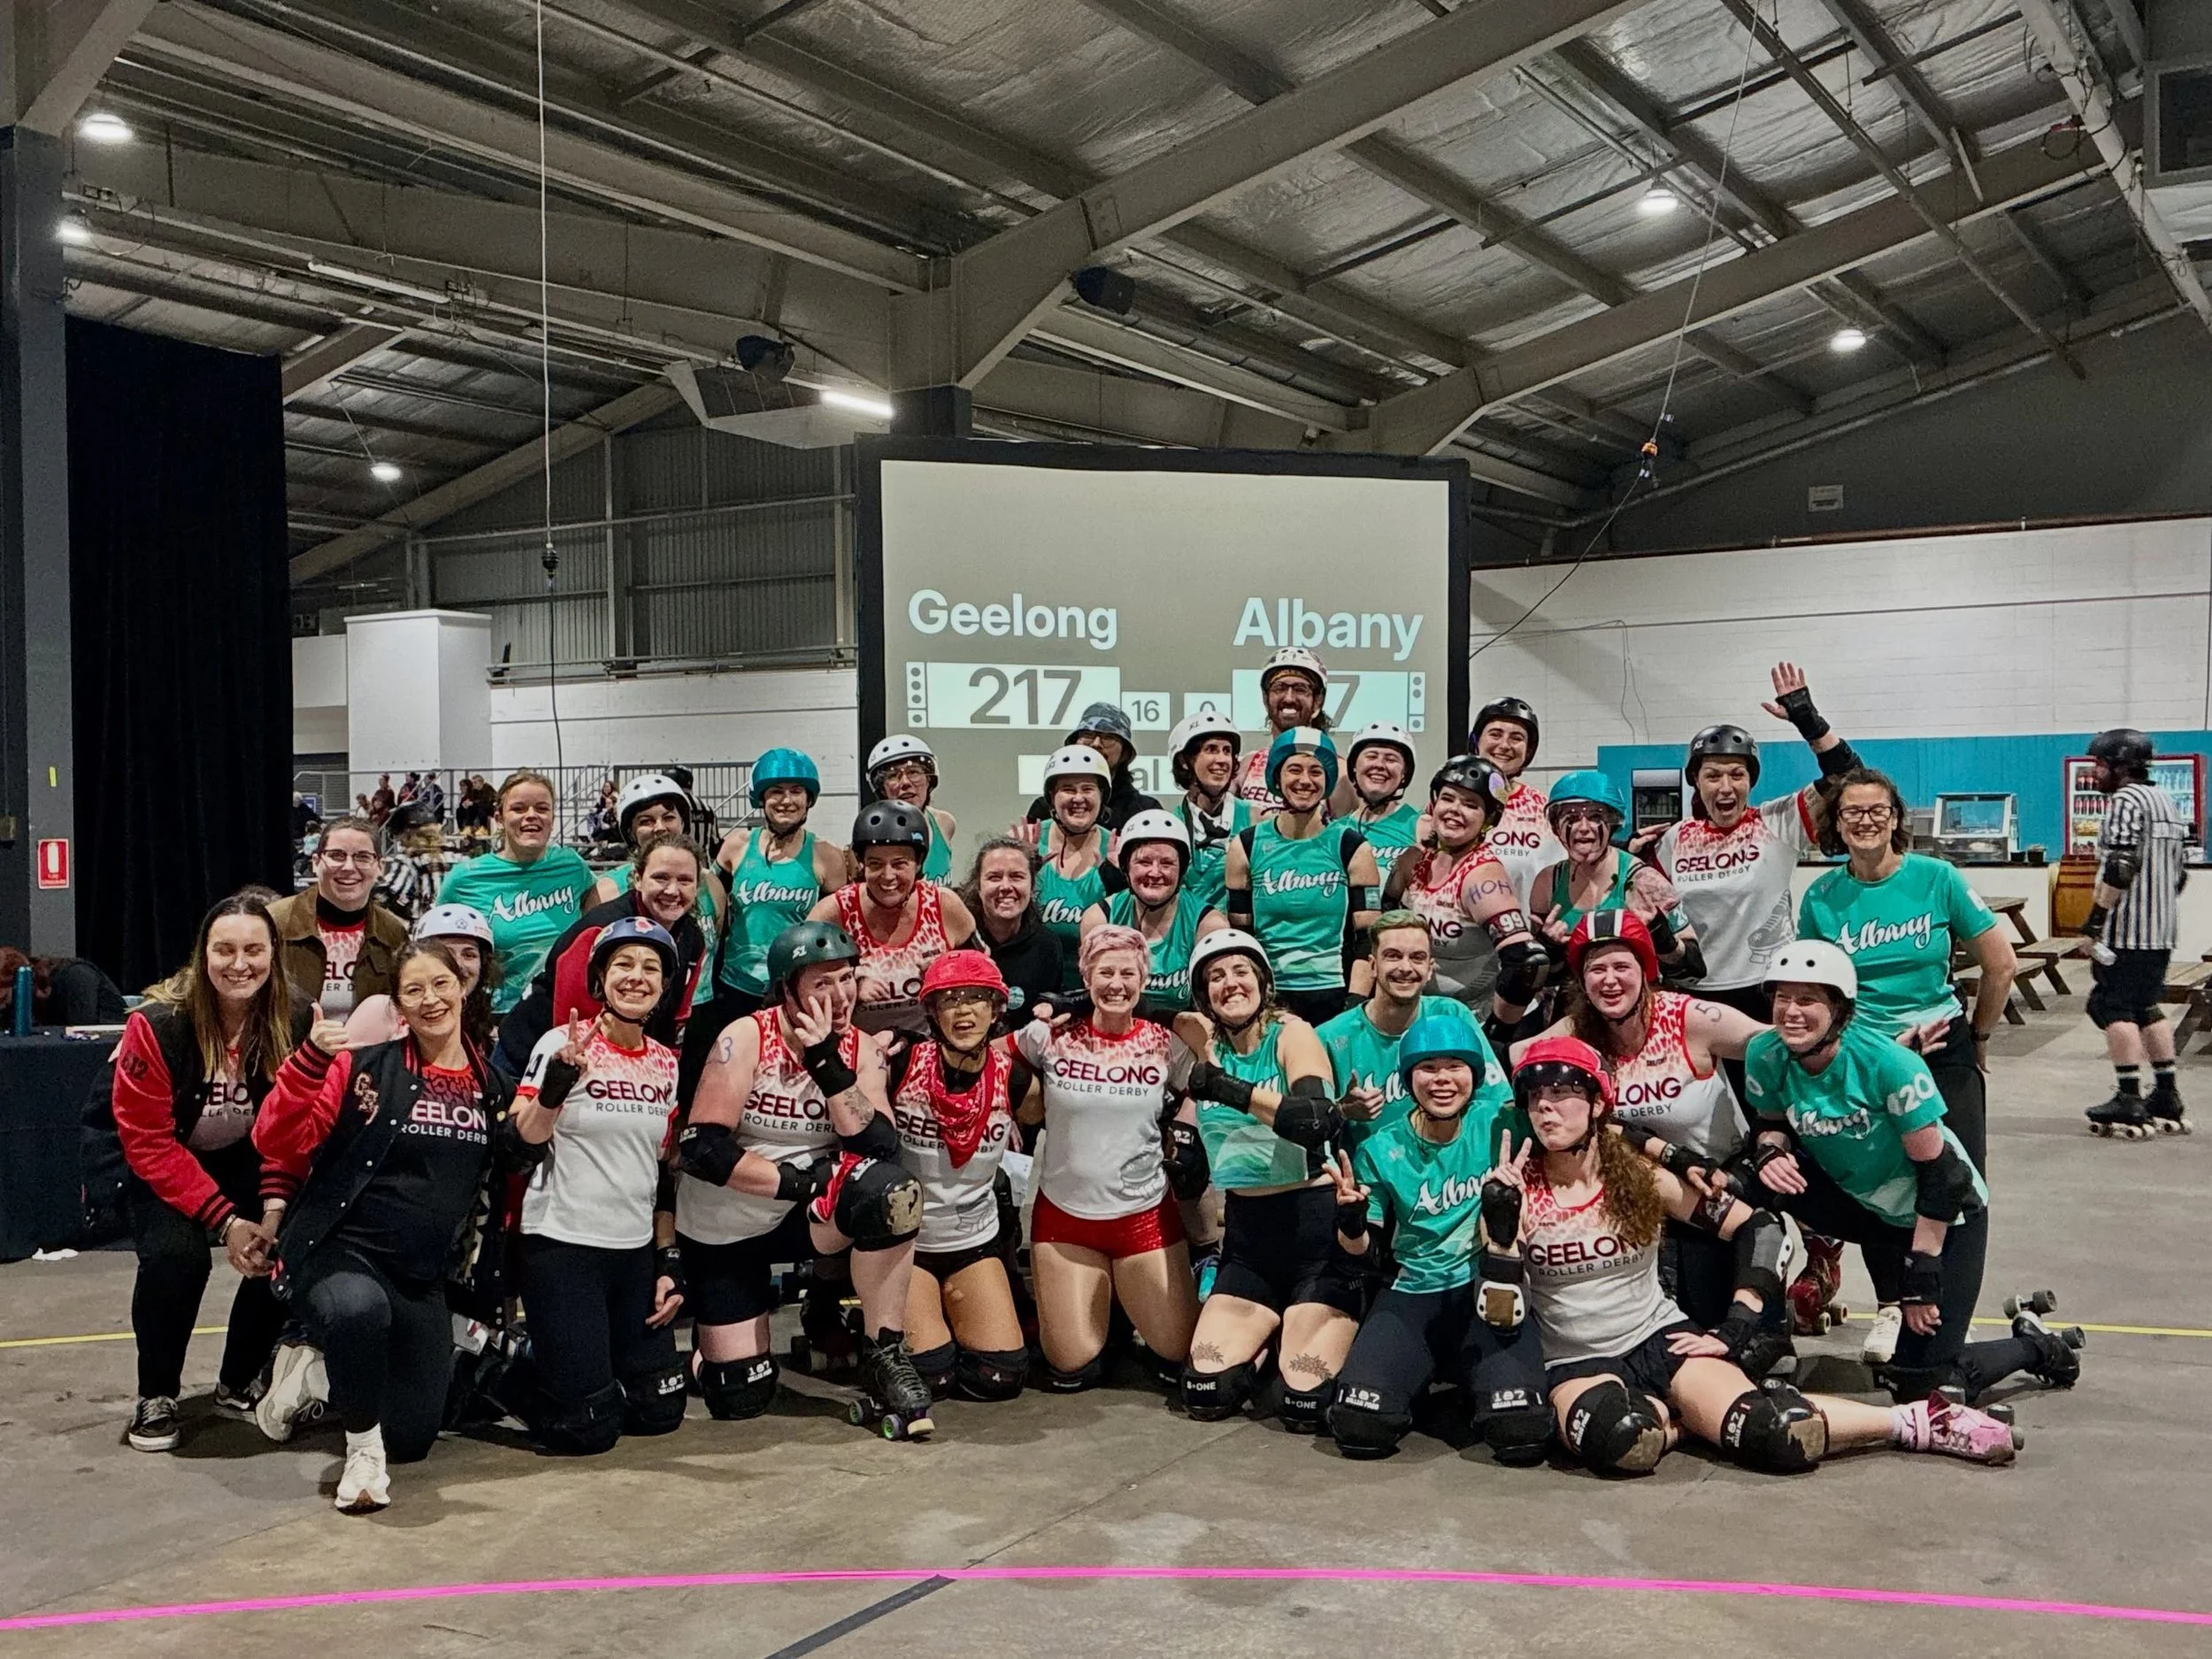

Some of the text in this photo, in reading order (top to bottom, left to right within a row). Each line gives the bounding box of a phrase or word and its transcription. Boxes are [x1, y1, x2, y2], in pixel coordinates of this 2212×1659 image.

[908, 588, 1118, 650] Geelong
[1233, 597, 1424, 661] Albany
[969, 667, 1081, 725] 217
[1327, 674, 1360, 727] 7
[1132, 700, 1159, 722] 16
[1675, 844, 1760, 874] GEELONG
[736, 879, 816, 913] Albany
[1262, 868, 1341, 897] Albany
[488, 885, 574, 925] Albany
[1834, 911, 1932, 955] Albany
[1054, 1058, 1161, 1086] GEELONG
[585, 1079, 673, 1106] GEELON
[1057, 1081, 1149, 1097] ROLLER DERBY
[1615, 1077, 1681, 1106] LONG
[411, 1099, 487, 1131] EELON
[596, 1102, 644, 1114] ROLLER
[744, 1090, 830, 1121] GEELO
[1631, 1103, 1672, 1118] DERBY
[744, 1112, 798, 1132] ROLLER
[457, 1129, 488, 1145] DERB
[1527, 1233, 1639, 1266] GEELON
[1540, 1253, 1646, 1278] ROLLER DERBY
